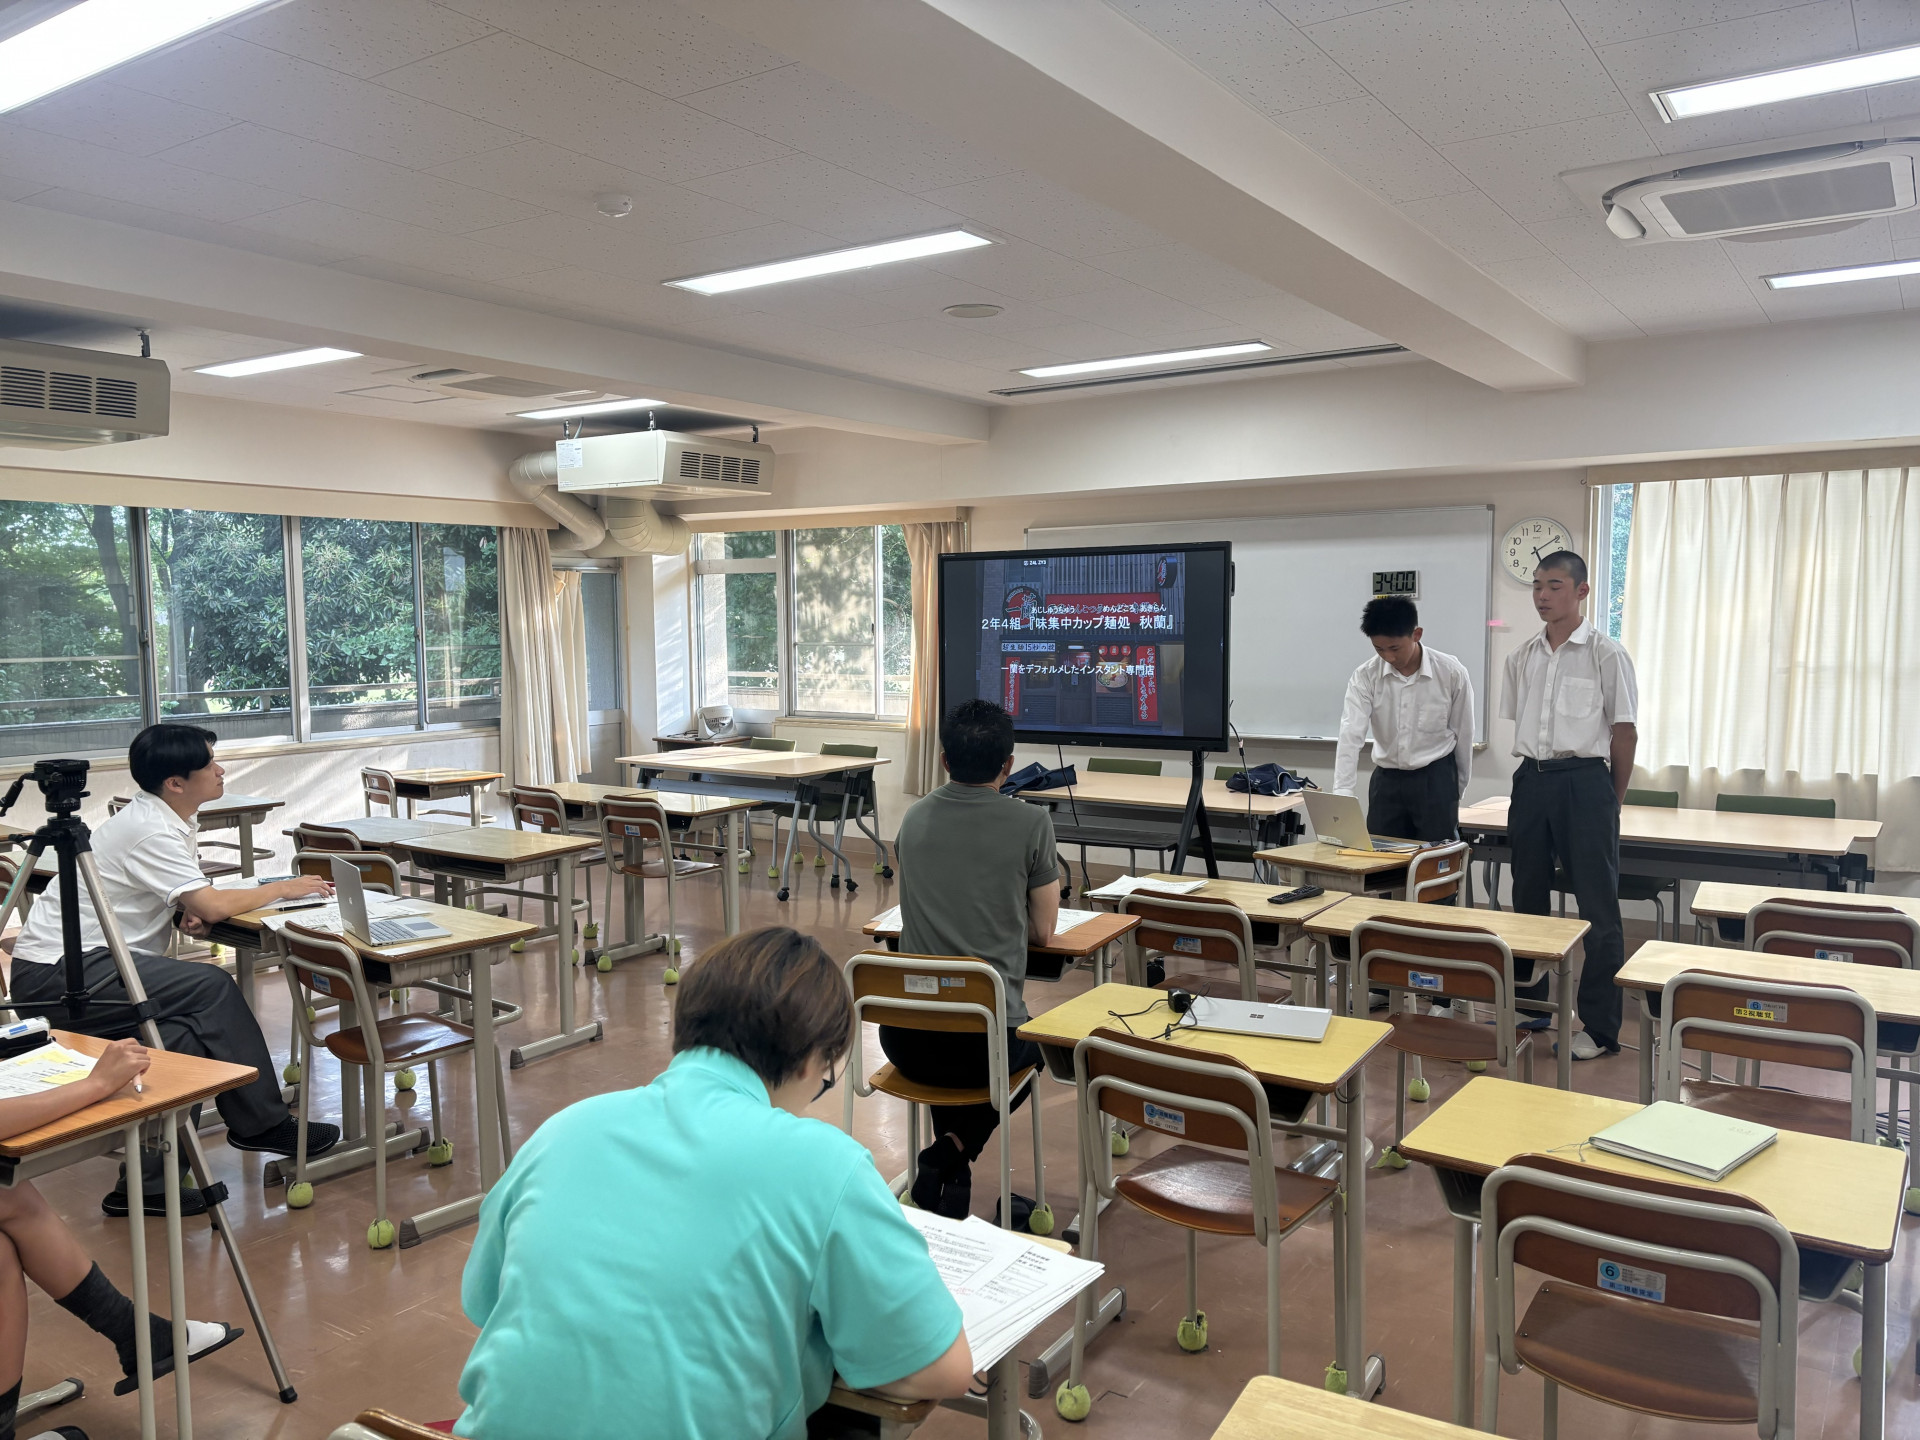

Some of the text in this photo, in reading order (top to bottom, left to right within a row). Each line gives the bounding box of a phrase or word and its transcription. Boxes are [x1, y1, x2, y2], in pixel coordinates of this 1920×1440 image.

[1522, 528, 1529, 536] 11
[1533, 524, 1542, 533] 12
[1513, 537, 1522, 545] 10
[1554, 535, 1561, 543] 2
[1509, 548, 1516, 556] 9
[1512, 559, 1520, 567] 8
[1522, 567, 1528, 575] 7
[1374, 571, 1415, 592] 34:00
[981, 617, 1021, 631] 2年4組
[1605, 1265, 1615, 1277] 6
